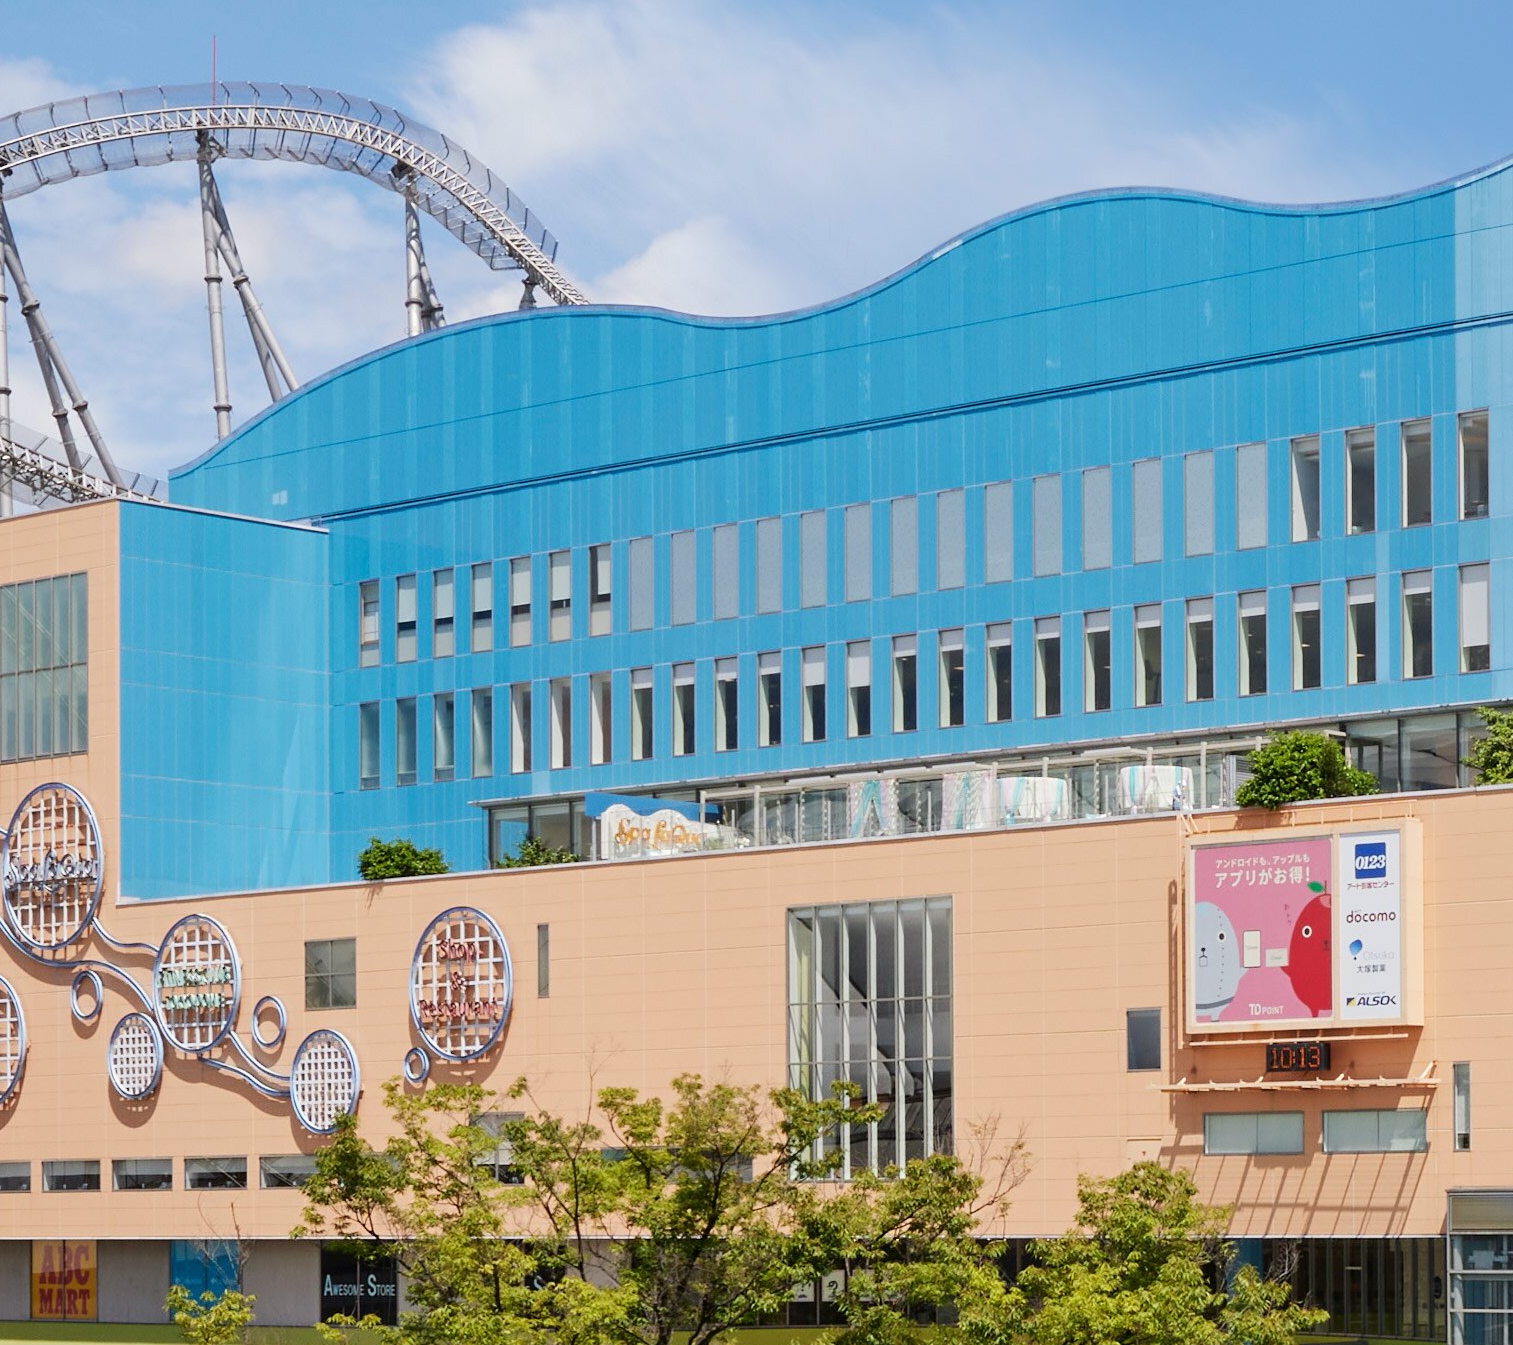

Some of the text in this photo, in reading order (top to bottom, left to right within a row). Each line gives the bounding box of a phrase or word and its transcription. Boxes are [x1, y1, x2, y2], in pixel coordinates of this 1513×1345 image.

[1355, 855, 1386, 870] 0123
[1346, 910, 1396, 923] docomo
[1363, 950, 1395, 961] Otsuka
[1356, 964, 1387, 974] 大塚製薬
[1357, 995, 1397, 1006] ALSOK
[1262, 1005, 1285, 1015] POINT
[1271, 1046, 1321, 1069] 10:13
[39, 1245, 90, 1285] ABC
[39, 1288, 91, 1315] MART
